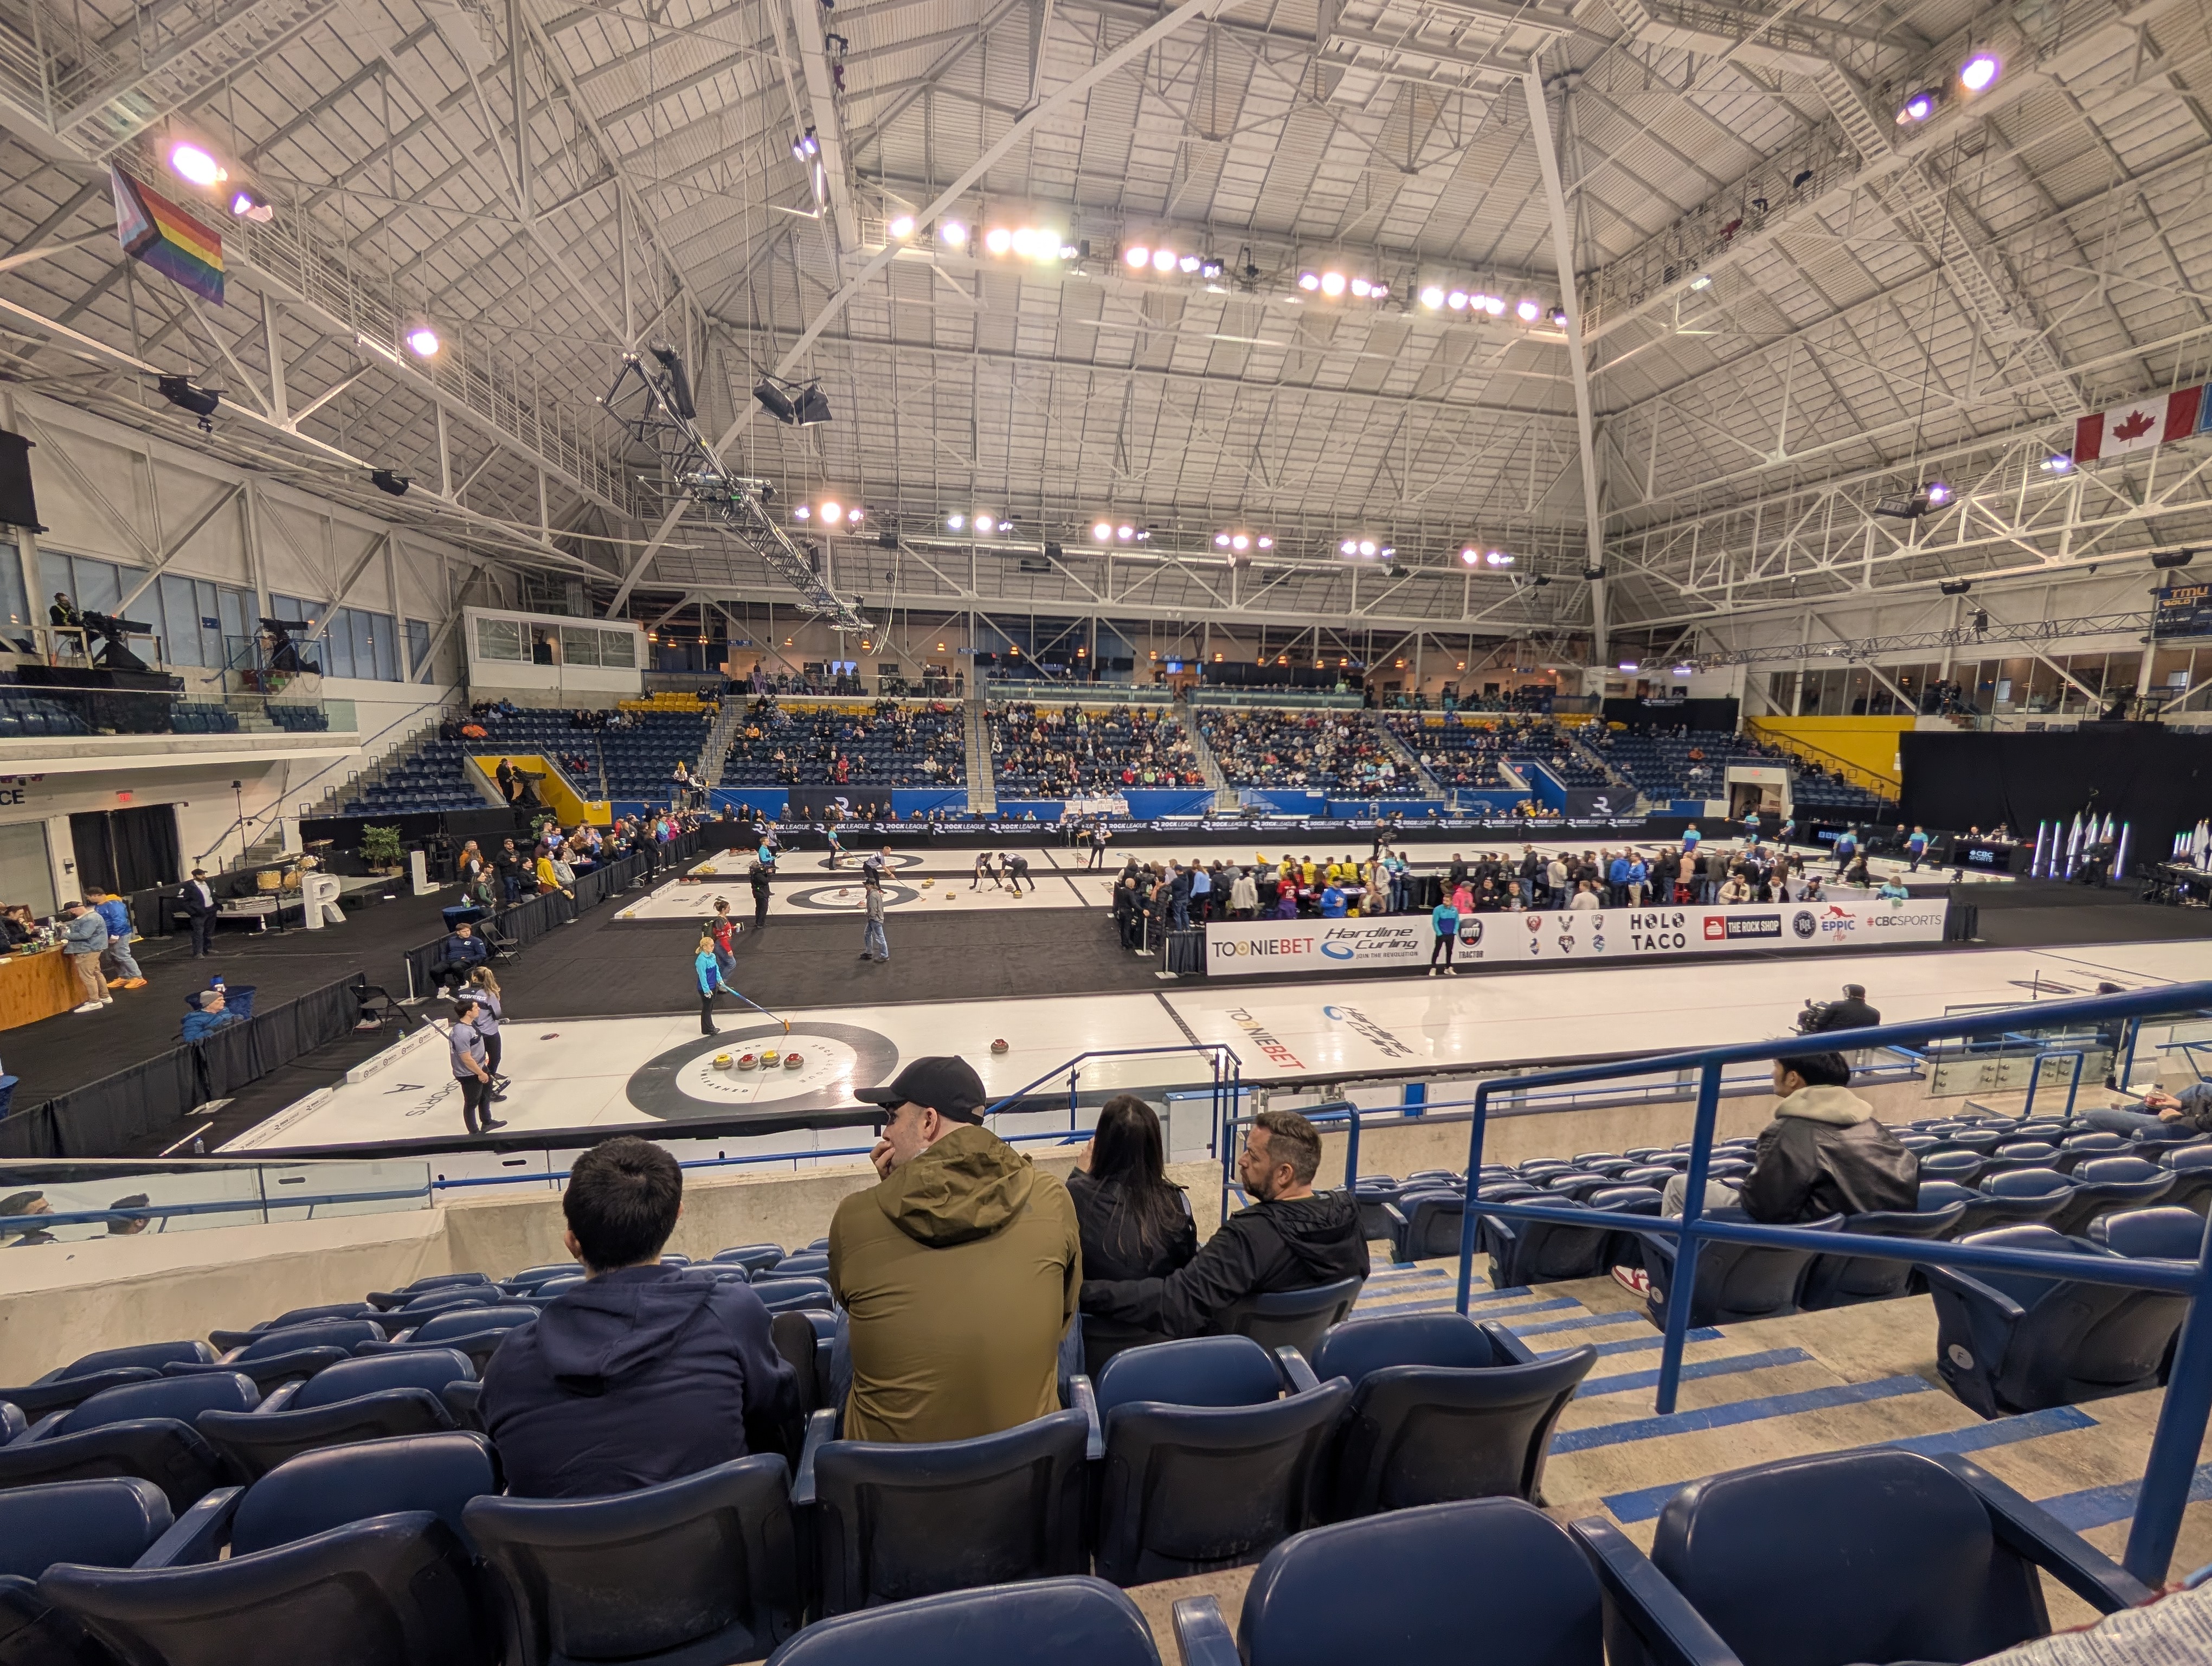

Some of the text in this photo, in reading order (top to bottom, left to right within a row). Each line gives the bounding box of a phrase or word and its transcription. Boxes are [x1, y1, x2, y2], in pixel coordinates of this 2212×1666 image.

[2171, 586, 2209, 598] TMU
[302, 873, 346, 929] R
[1630, 912, 1685, 930] HOLO
[1727, 920, 1779, 933] THE ROCK SHOP
[1821, 920, 1855, 931] EPPIC
[1324, 927, 1414, 939] Hardline
[1631, 932, 1686, 951] TACO
[1212, 938, 1315, 958] TOONIEBET
[1355, 939, 1419, 950] Curling
[1458, 950, 1484, 958] TRACTOR
[1225, 1007, 1306, 1069] TOONIEBET
[1339, 1005, 1414, 1054] Hardline
[1346, 1021, 1402, 1058] Curling
